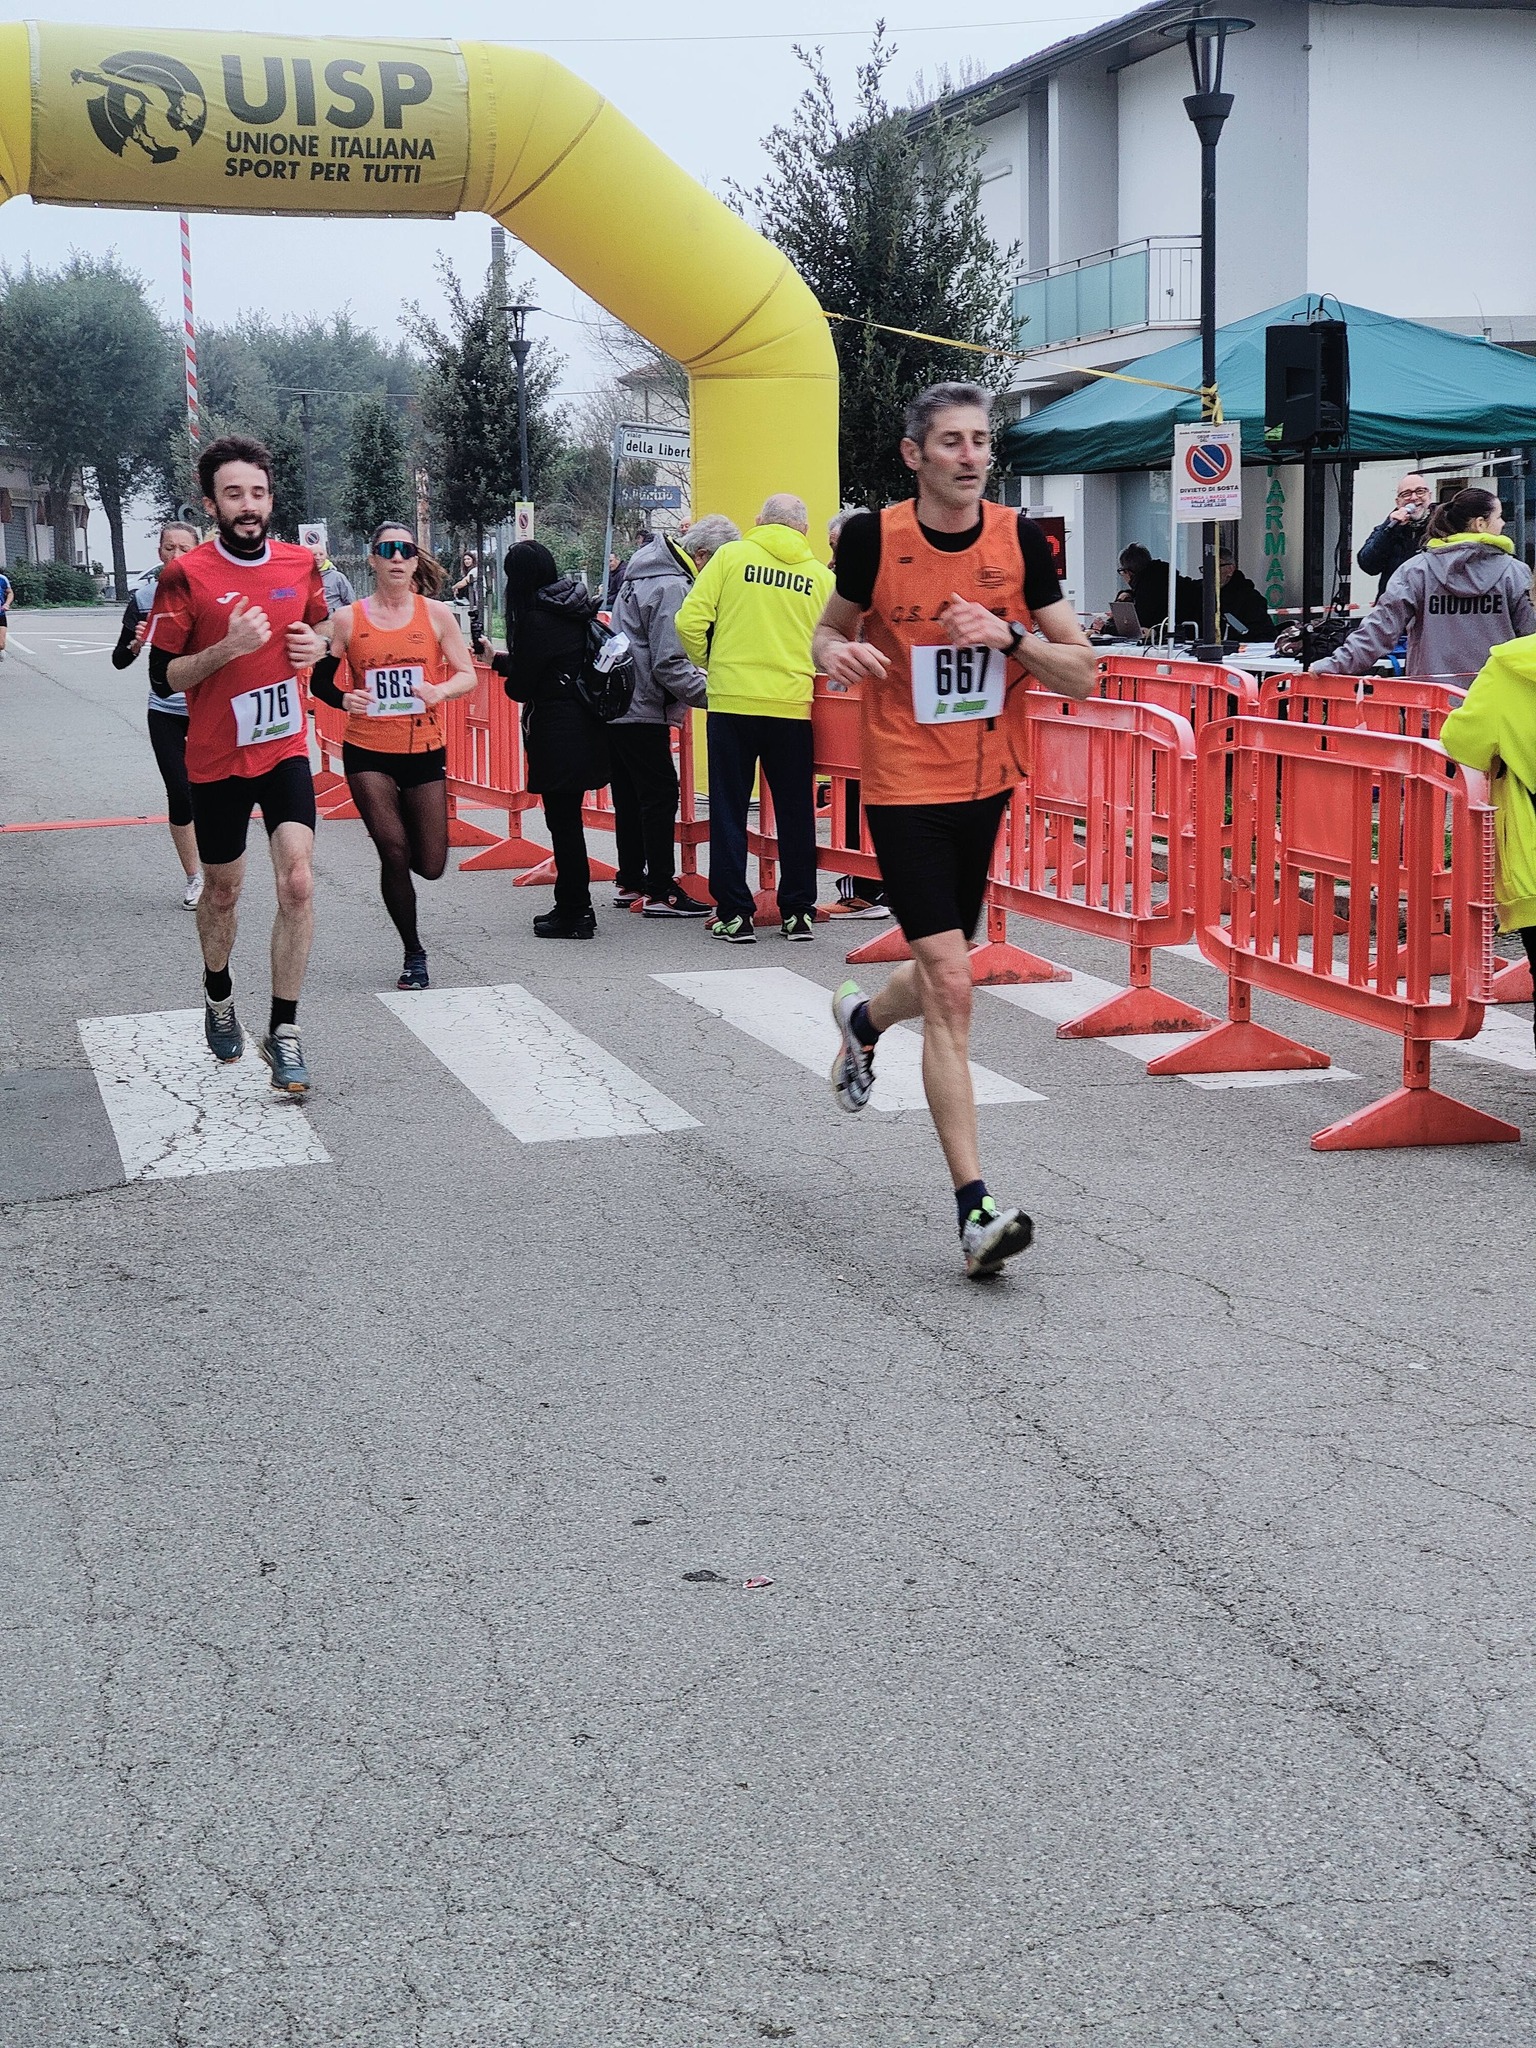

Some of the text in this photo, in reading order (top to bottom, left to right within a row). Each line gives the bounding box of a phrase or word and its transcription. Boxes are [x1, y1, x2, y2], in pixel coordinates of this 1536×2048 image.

[221, 54, 433, 130] UISP
[226, 131, 436, 160] UNIONE ITALIANA
[224, 158, 422, 184] SPORT PER TUTTI
[626, 440, 653, 454] della
[744, 564, 814, 596] GIUDICE
[1428, 595, 1503, 615] GIUDICE
[376, 669, 413, 699] 683
[936, 646, 991, 696] 667
[250, 683, 290, 726] 776
